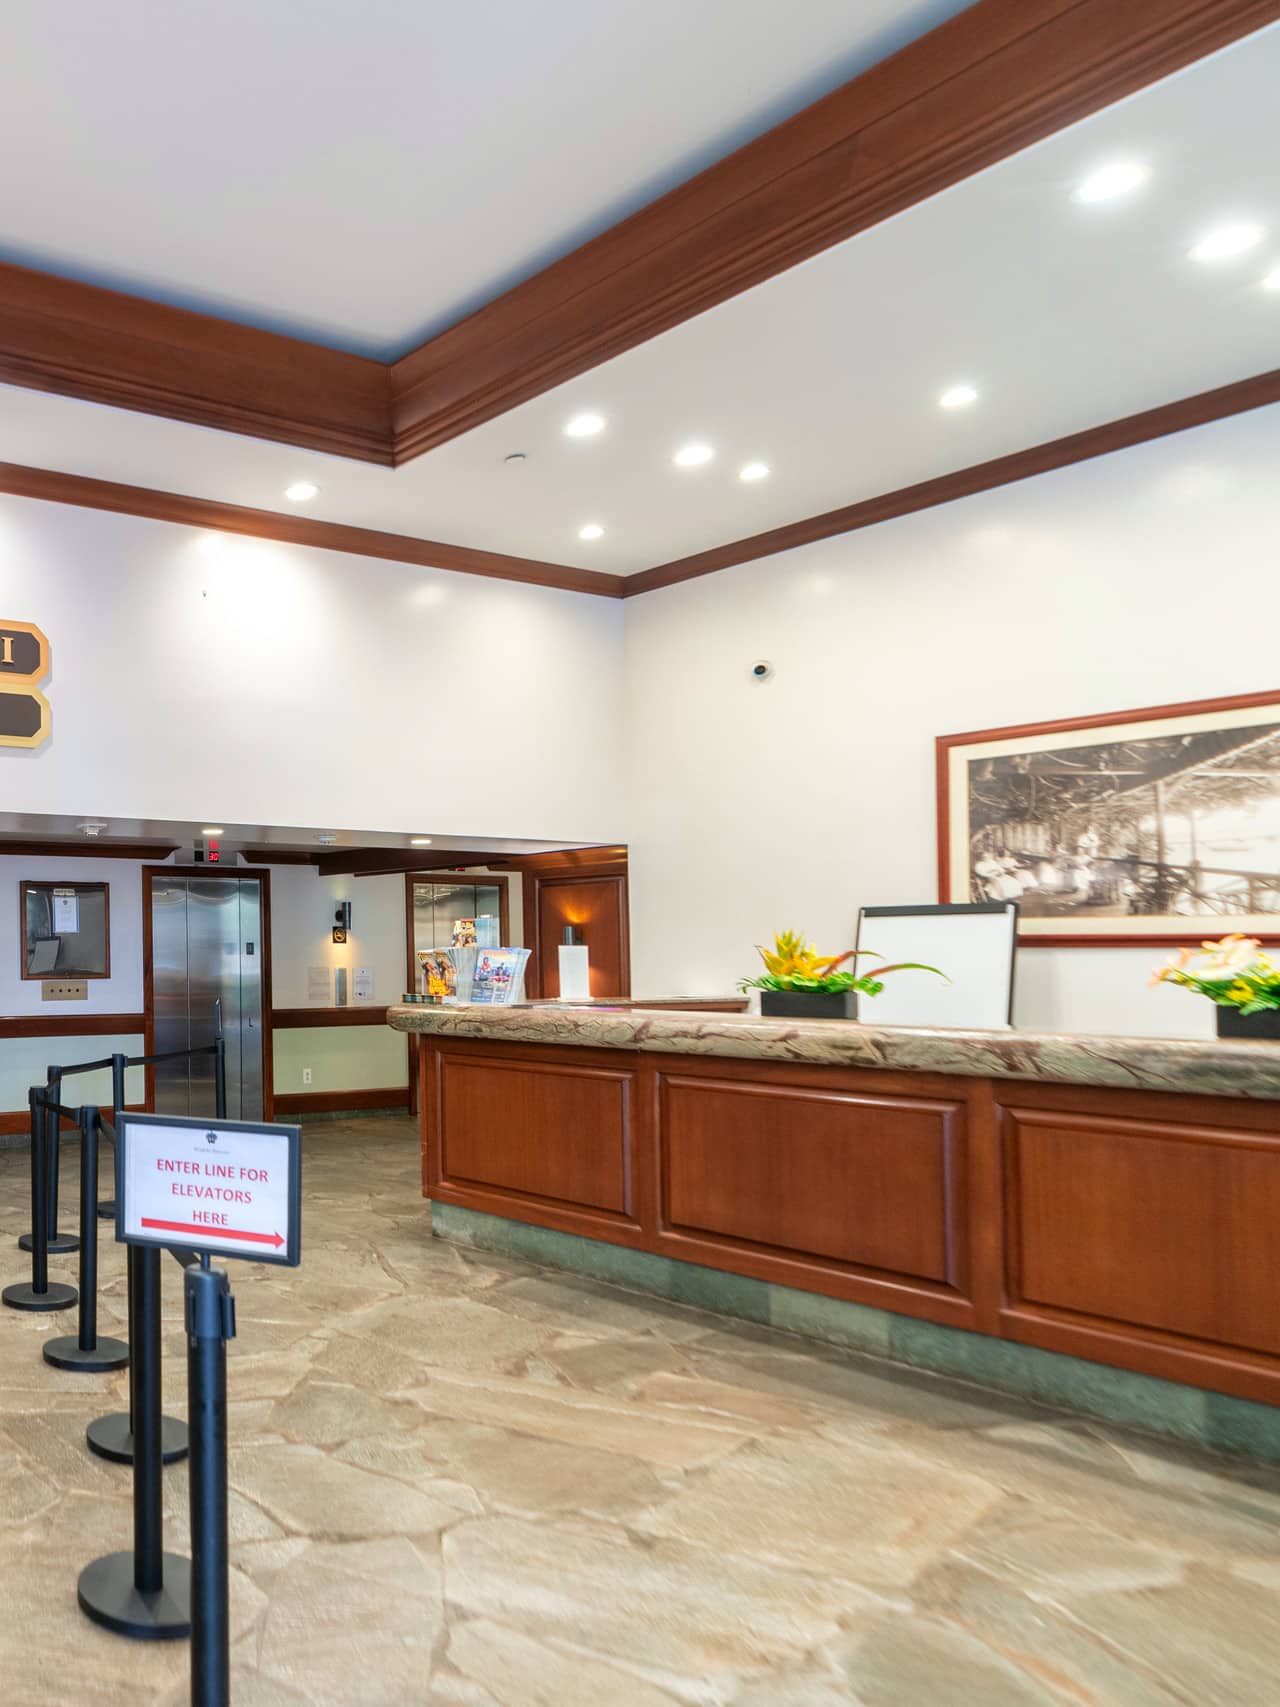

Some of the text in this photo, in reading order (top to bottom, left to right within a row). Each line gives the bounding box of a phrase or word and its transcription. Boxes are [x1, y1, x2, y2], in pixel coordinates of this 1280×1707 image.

[156, 1158, 269, 1182] ENTER LINE FOR
[171, 1183, 252, 1204] ELEVATORS
[192, 1210, 229, 1226] HERE
